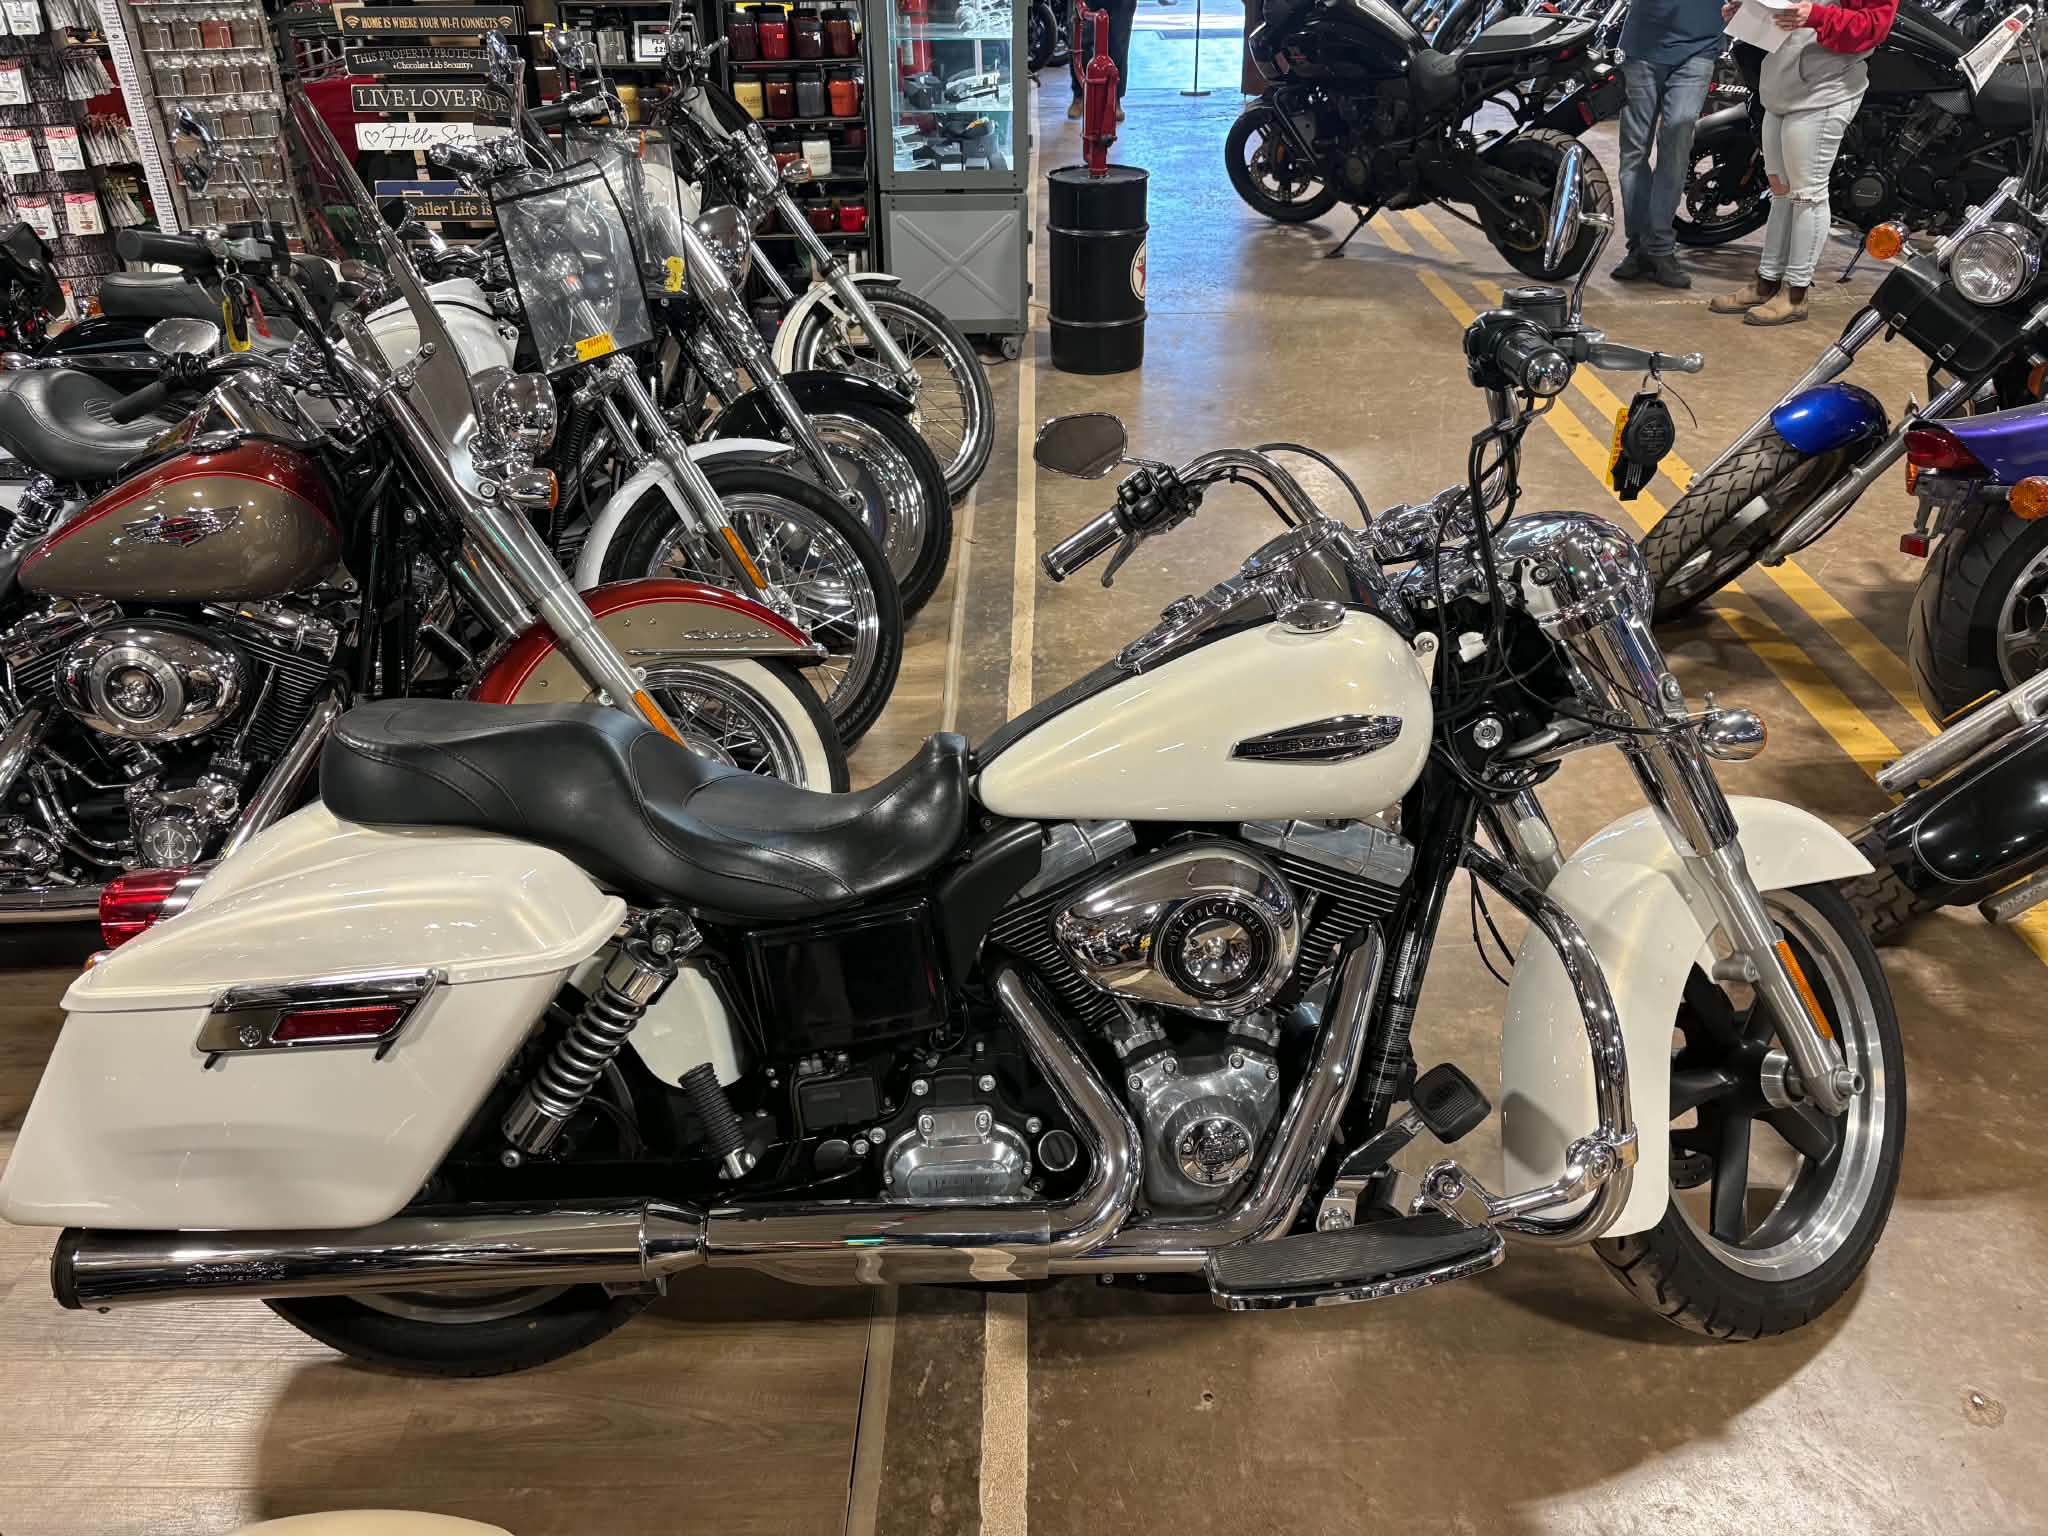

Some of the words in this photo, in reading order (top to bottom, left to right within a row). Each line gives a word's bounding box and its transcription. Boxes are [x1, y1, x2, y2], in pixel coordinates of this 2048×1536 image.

[361, 16, 382, 29] HOME
[383, 16, 391, 29] IS
[392, 16, 418, 29] WHERE
[419, 16, 439, 29] YOUR
[440, 16, 460, 29] WI-FI
[460, 16, 499, 29] CONNECTS
[352, 51, 378, 64] THIS
[379, 48, 432, 61] PROPERTY
[434, 47, 489, 60] PROTECTE
[396, 61, 429, 70] Chocolate
[430, 61, 443, 69] Lab
[444, 61, 471, 71] Security
[382, 125, 438, 148] Hello
[441, 124, 486, 146] Spr
[415, 200, 448, 216] ailer
[449, 199, 479, 216] Life
[480, 203, 493, 216] is
[1225, 905, 1264, 937] INCHES
